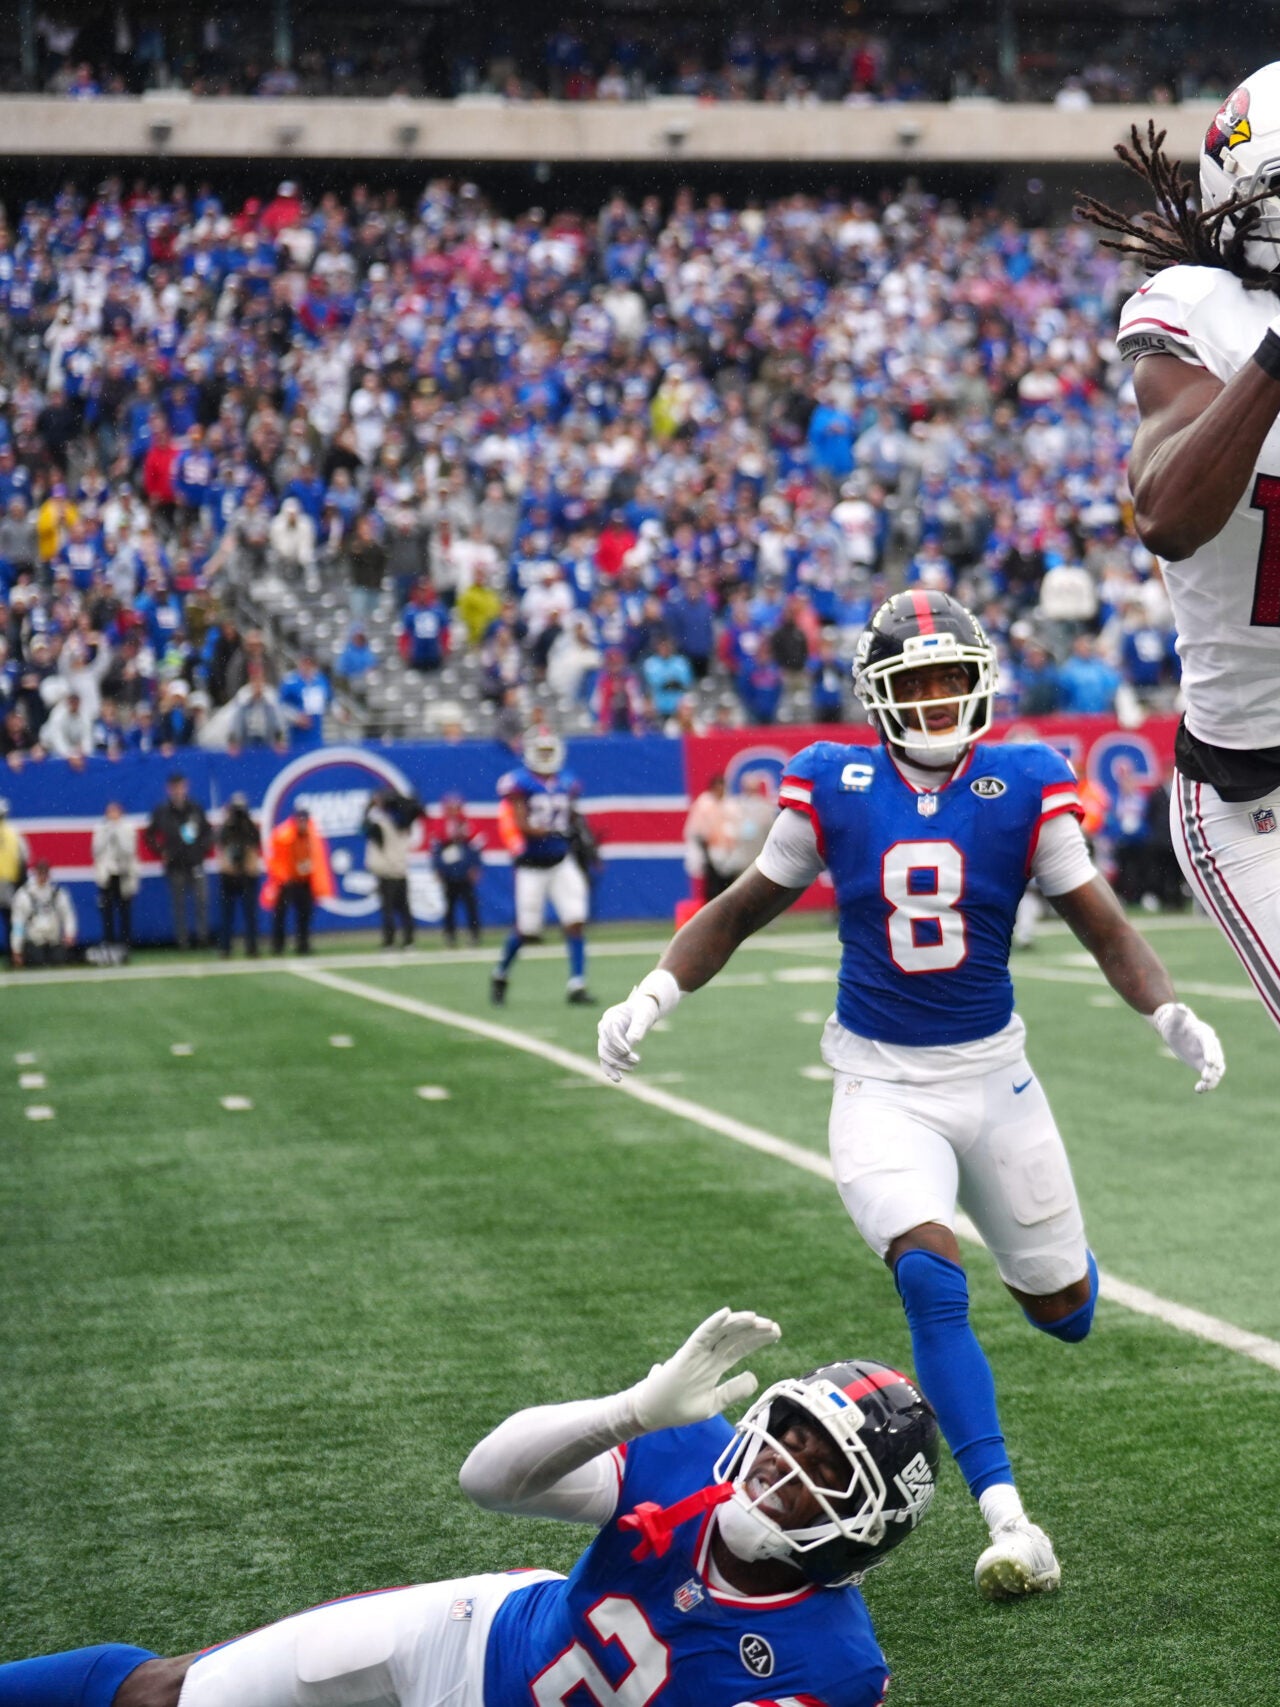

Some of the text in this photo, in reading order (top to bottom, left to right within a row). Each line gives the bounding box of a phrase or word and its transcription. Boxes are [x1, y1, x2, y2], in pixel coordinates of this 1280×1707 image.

[841, 763, 874, 786] C
[976, 780, 1001, 794] EA
[880, 840, 968, 975] 8
[529, 1592, 672, 1707] 2
[743, 1639, 769, 1673] EA
